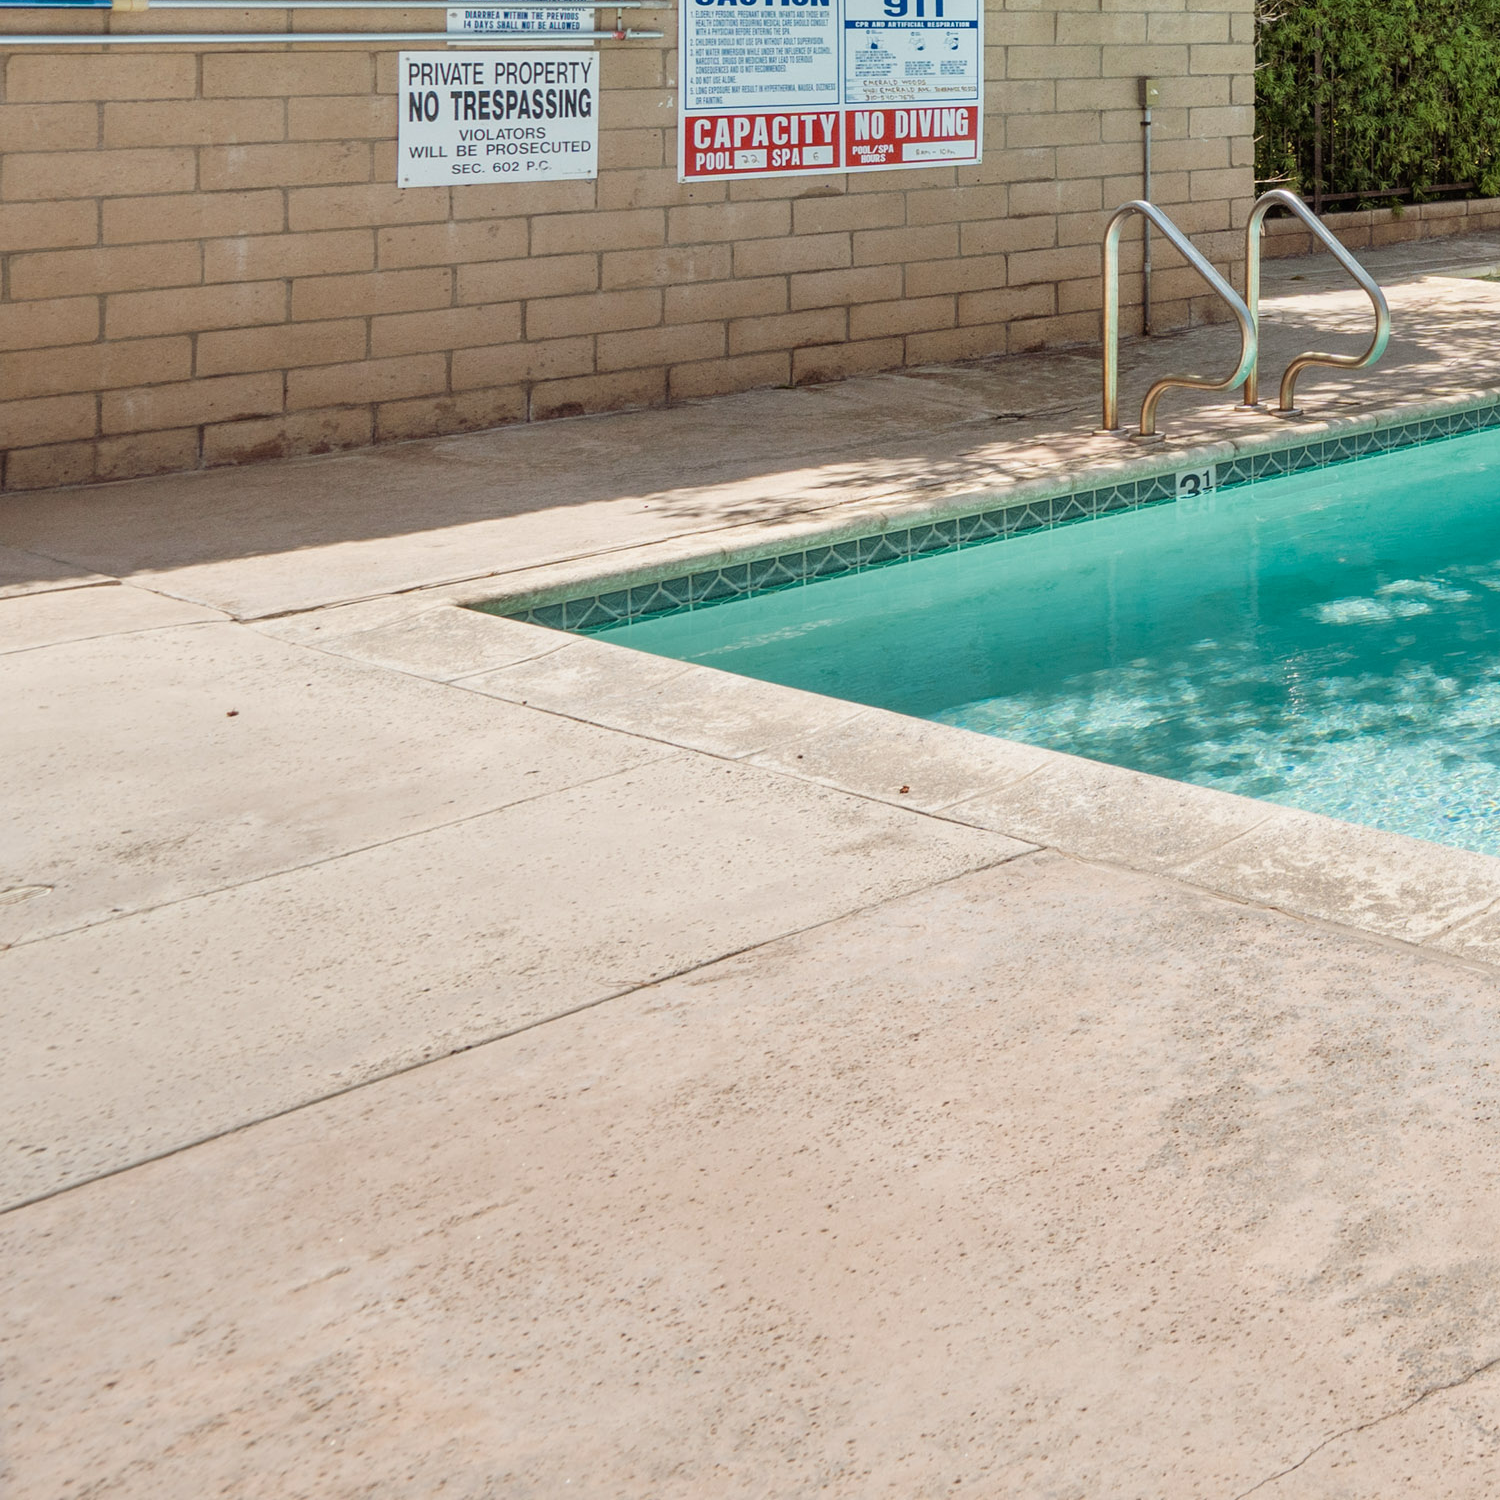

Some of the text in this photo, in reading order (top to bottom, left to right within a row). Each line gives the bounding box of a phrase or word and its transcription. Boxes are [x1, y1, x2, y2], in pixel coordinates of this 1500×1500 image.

[465, 10, 579, 20] DIARRHEA WITHIN THE PREVIOUS
[463, 20, 472, 29] 14
[474, 21, 494, 29] DAYS
[496, 21, 518, 30] SHALL
[521, 21, 534, 30] NOT
[538, 21, 547, 30] BE
[549, 21, 581, 31] ALLOWED
[408, 61, 592, 86] PRIVATE PROPERTY
[408, 88, 592, 122] NO TRESPASSING
[693, 113, 837, 150] CAPACITY
[854, 108, 969, 141] NO DIVING
[459, 127, 546, 141] VIOLATORS
[409, 140, 592, 158] WILL BE PROSECUTED
[852, 144, 894, 155] POOL/SPA
[695, 152, 734, 171] POOL
[772, 148, 801, 167] SPA
[861, 154, 886, 164] HOURS
[451, 160, 552, 175] SEC. 602 P.C.
